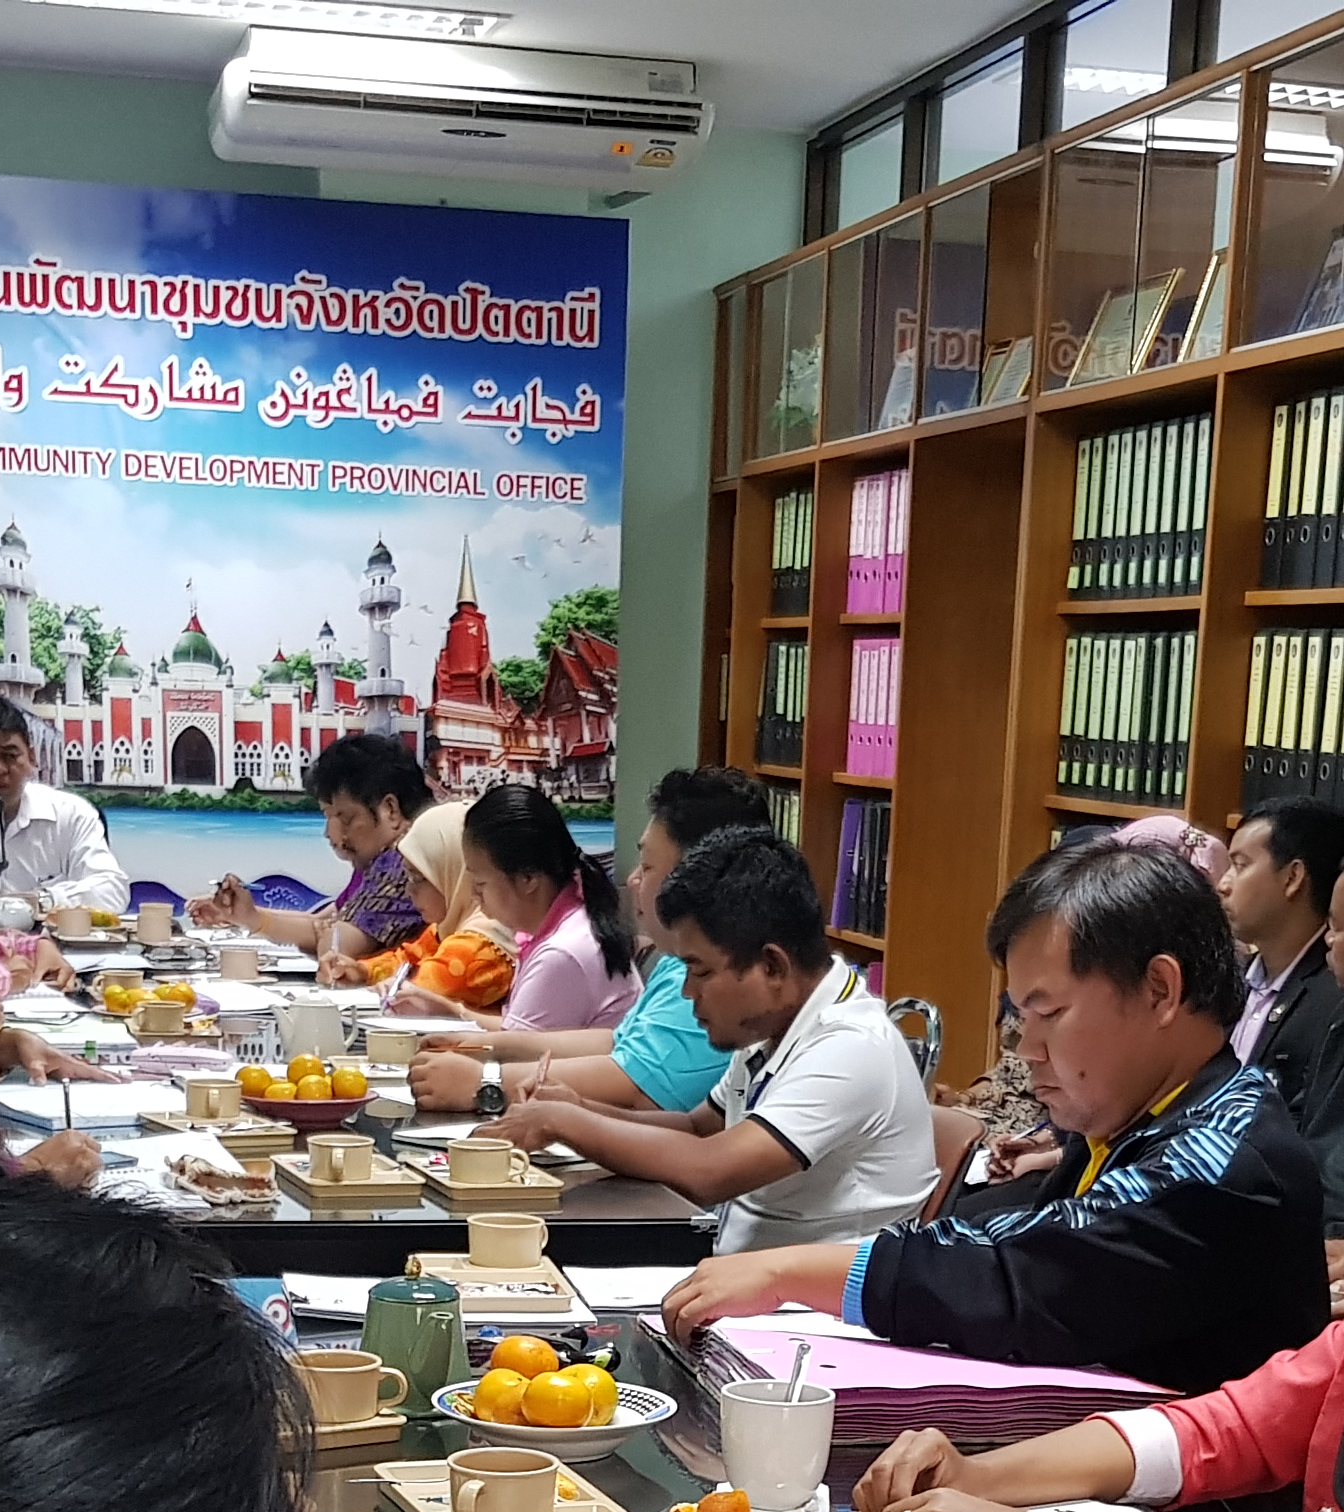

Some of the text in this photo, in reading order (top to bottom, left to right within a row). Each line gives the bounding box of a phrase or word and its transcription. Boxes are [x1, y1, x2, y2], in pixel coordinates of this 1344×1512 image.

[124, 452, 320, 488] DEVELOPMENT
[331, 464, 485, 498] PROVINCIAL
[496, 472, 585, 501] OFFICE
